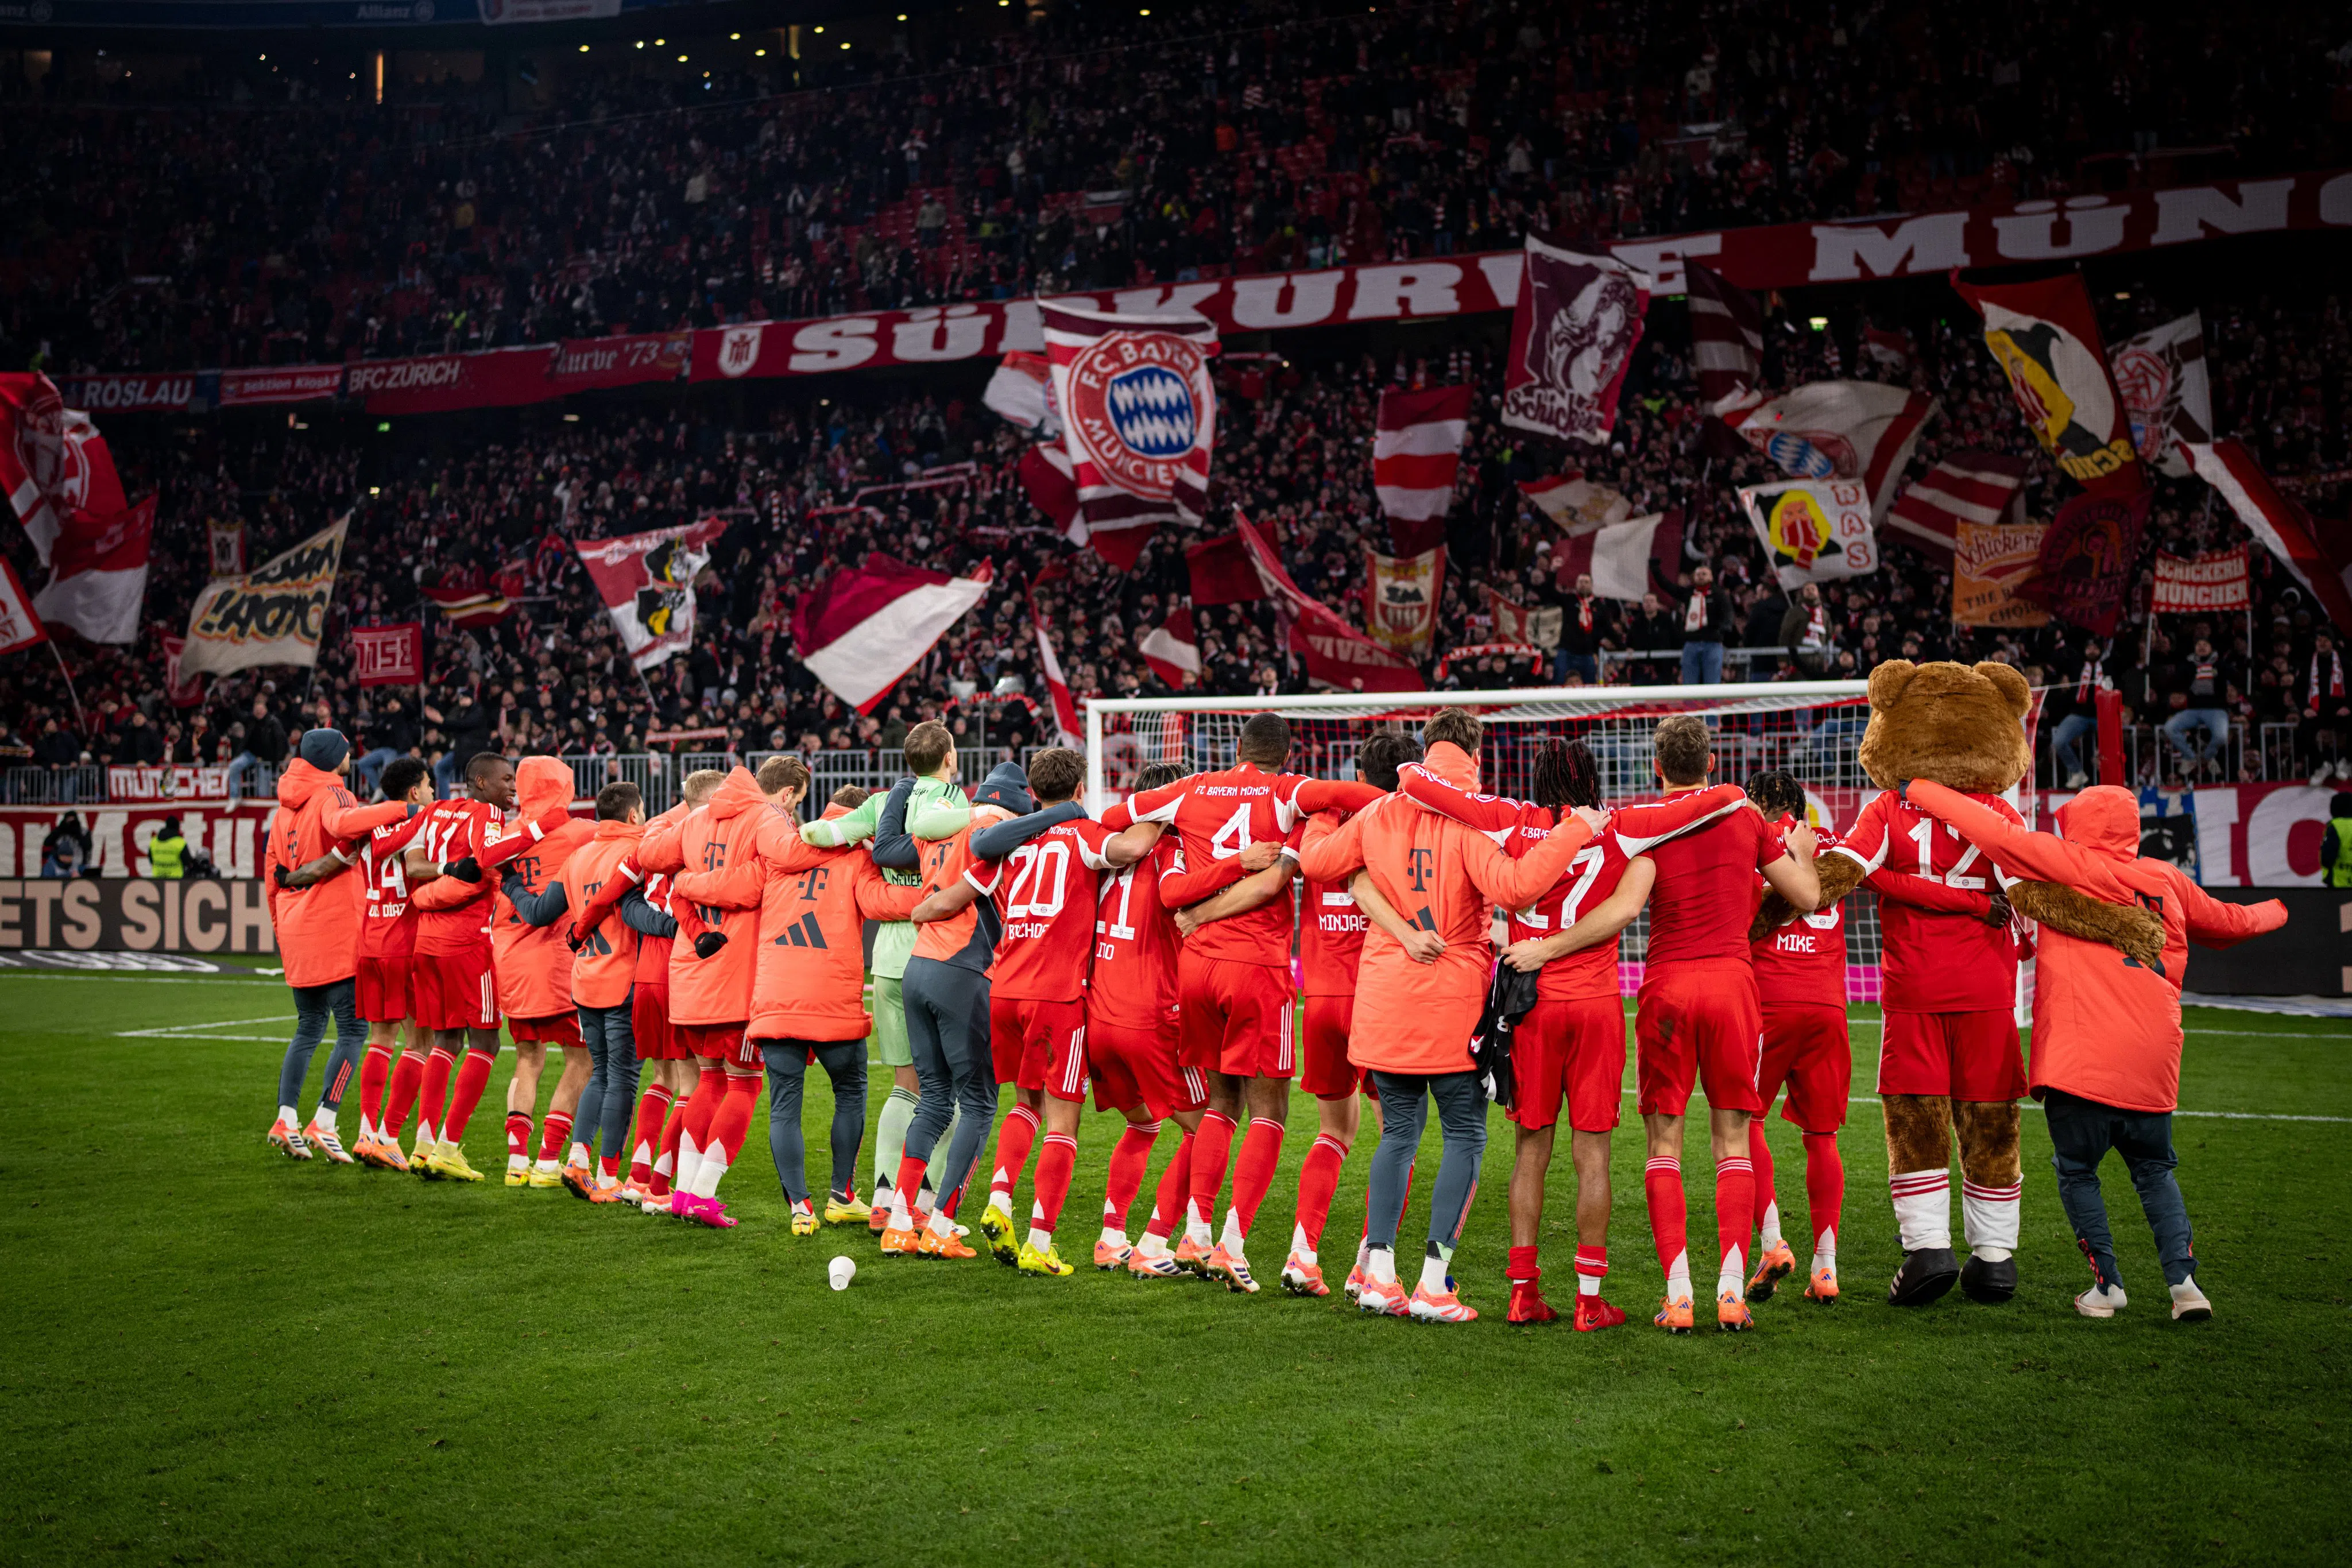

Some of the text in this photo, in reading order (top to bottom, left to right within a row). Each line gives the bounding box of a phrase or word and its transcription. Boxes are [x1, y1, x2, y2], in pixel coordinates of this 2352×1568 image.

[348, 358, 462, 393] BFC ZÜRICH
[82, 377, 194, 407] RÖSLAU
[2155, 554, 2246, 582] SCHICKERIA
[2154, 578, 2248, 607] MÜNCHEN
[1194, 785, 1206, 795] FC
[1206, 786, 1238, 796] BAYERN
[1899, 800, 1912, 810] FC
[1210, 802, 1252, 860] 4
[1907, 817, 1987, 890] 12
[361, 841, 407, 901] 14
[1006, 840, 1070, 919] 20
[1318, 914, 1369, 931] MINJAE
[1776, 933, 1816, 953] MIKE
